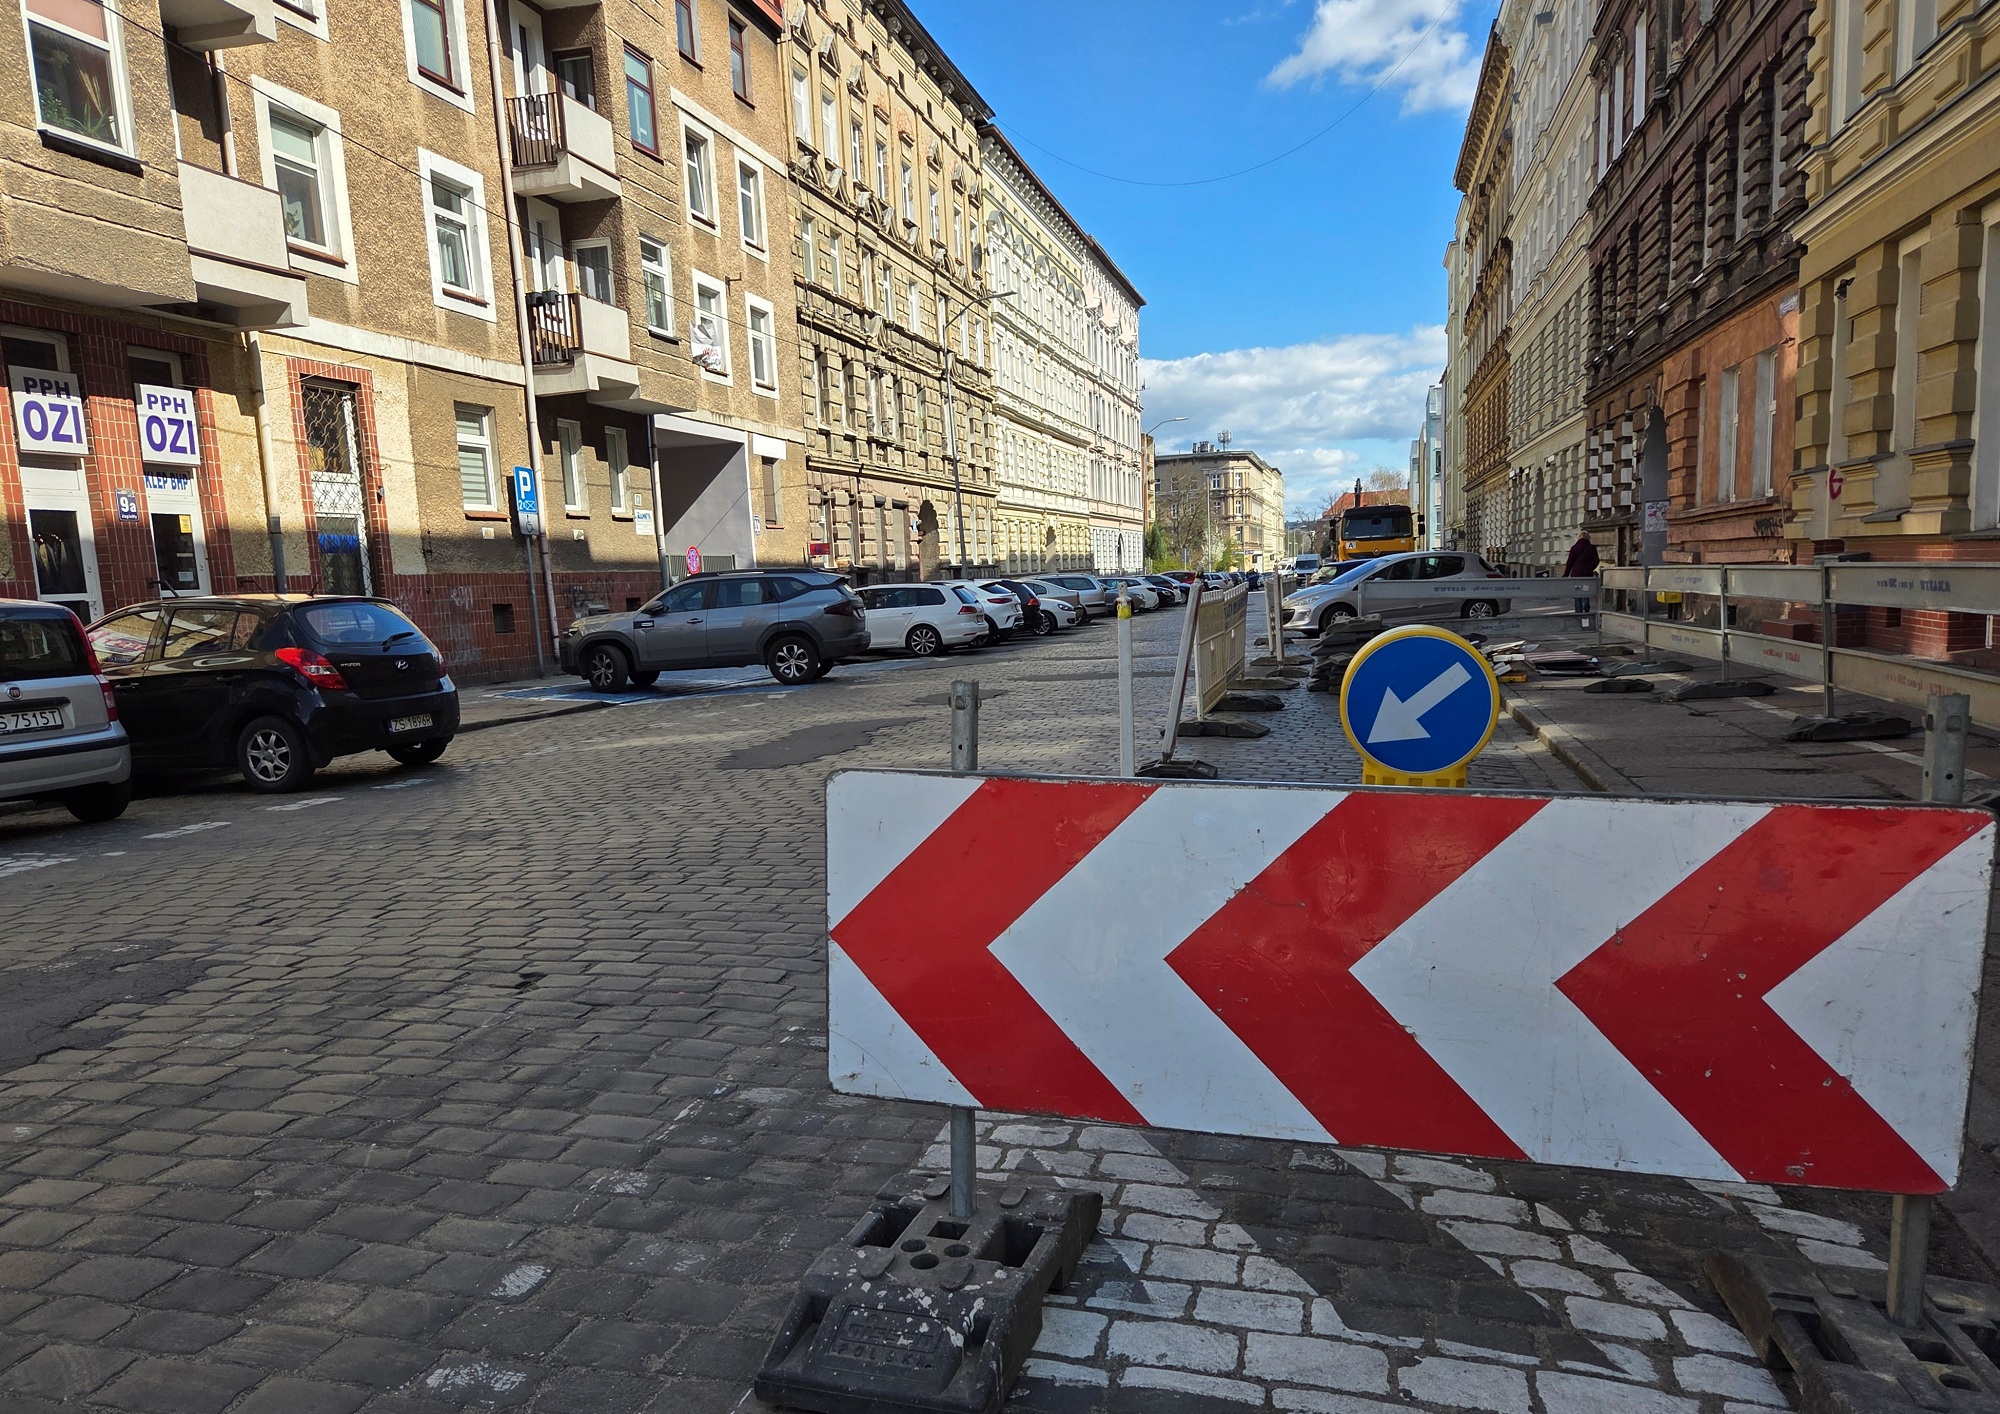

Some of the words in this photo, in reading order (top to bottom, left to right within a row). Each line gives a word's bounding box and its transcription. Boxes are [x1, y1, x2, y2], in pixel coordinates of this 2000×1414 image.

[23, 377, 71, 399] PPH
[146, 394, 187, 415] PPH
[22, 400, 83, 444] OZI
[145, 415, 196, 455] OZI
[170, 472, 188, 491] BHP
[518, 470, 532, 499] P
[120, 496, 137, 513] 9a
[10, 710, 58, 729] 7515T
[392, 719, 406, 731] ZS
[408, 714, 432, 728] 1896R
